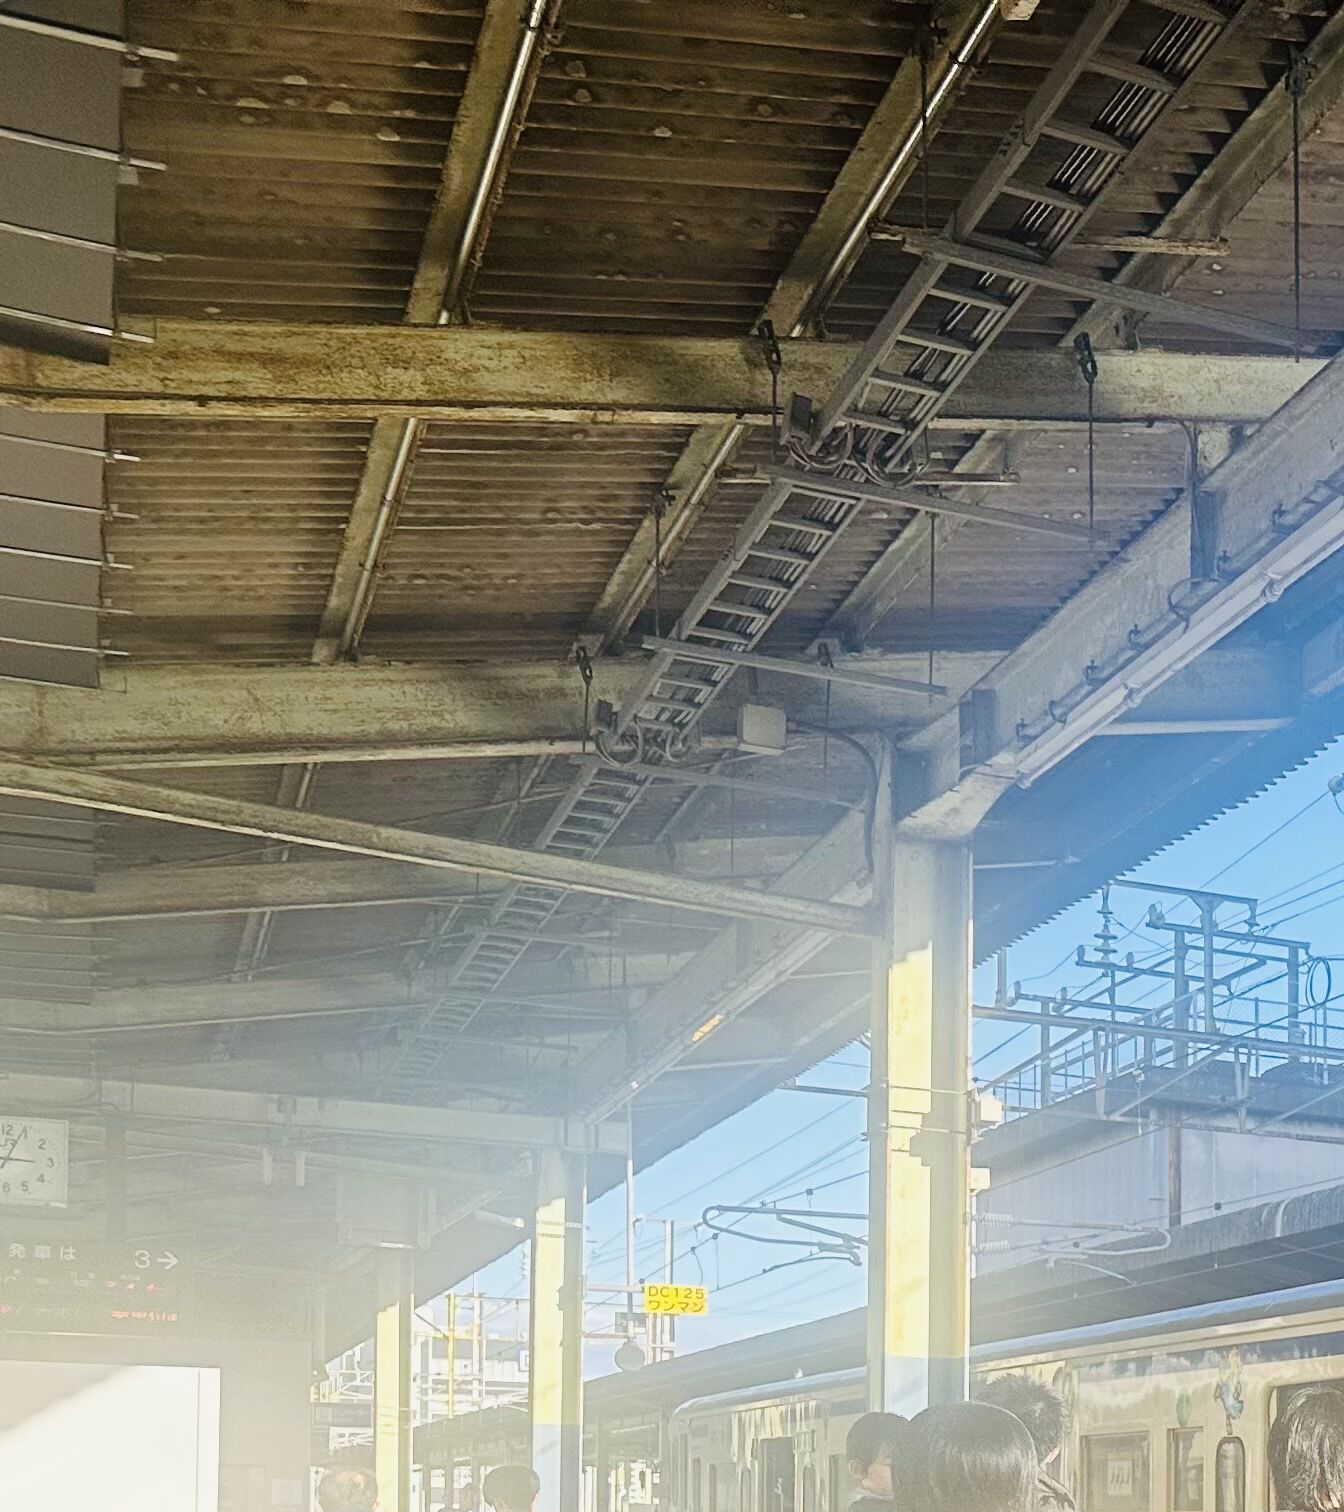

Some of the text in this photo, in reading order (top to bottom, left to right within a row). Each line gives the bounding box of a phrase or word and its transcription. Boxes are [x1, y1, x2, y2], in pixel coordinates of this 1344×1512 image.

[134, 1250, 151, 1268] 3
[648, 1286, 704, 1299] DC125
[648, 1300, 704, 1312] ワンマン
